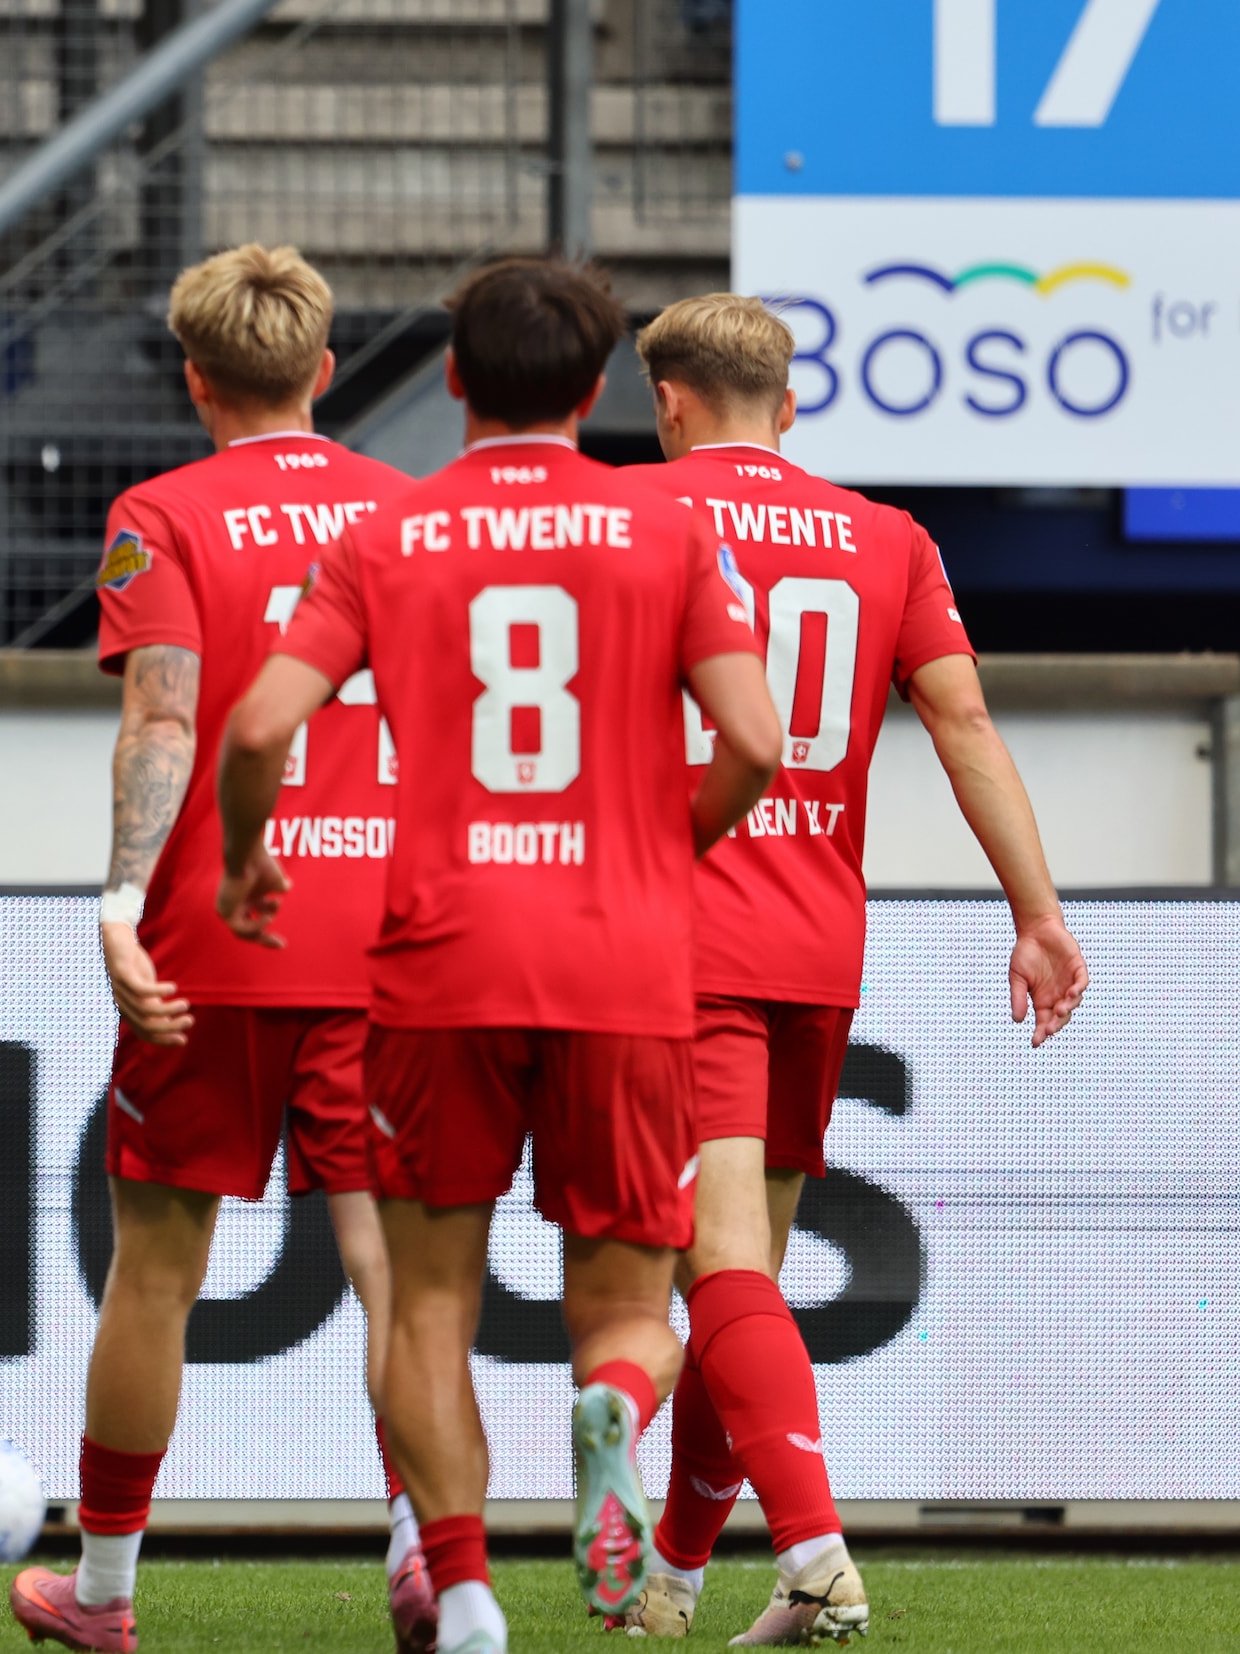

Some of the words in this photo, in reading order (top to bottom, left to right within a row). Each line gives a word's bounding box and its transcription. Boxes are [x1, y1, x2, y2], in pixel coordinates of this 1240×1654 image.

[274, 453, 328, 471] 1965
[491, 466, 548, 484] 1965
[734, 465, 782, 481] 1965
[223, 504, 278, 550] FC
[280, 500, 377, 545] TWE
[401, 511, 451, 557] FC
[461, 503, 633, 550] TWENTE
[705, 497, 857, 554] TWENTE
[469, 585, 580, 793] 8
[263, 816, 396, 858] LYNSSO
[468, 820, 585, 866] BOOTH
